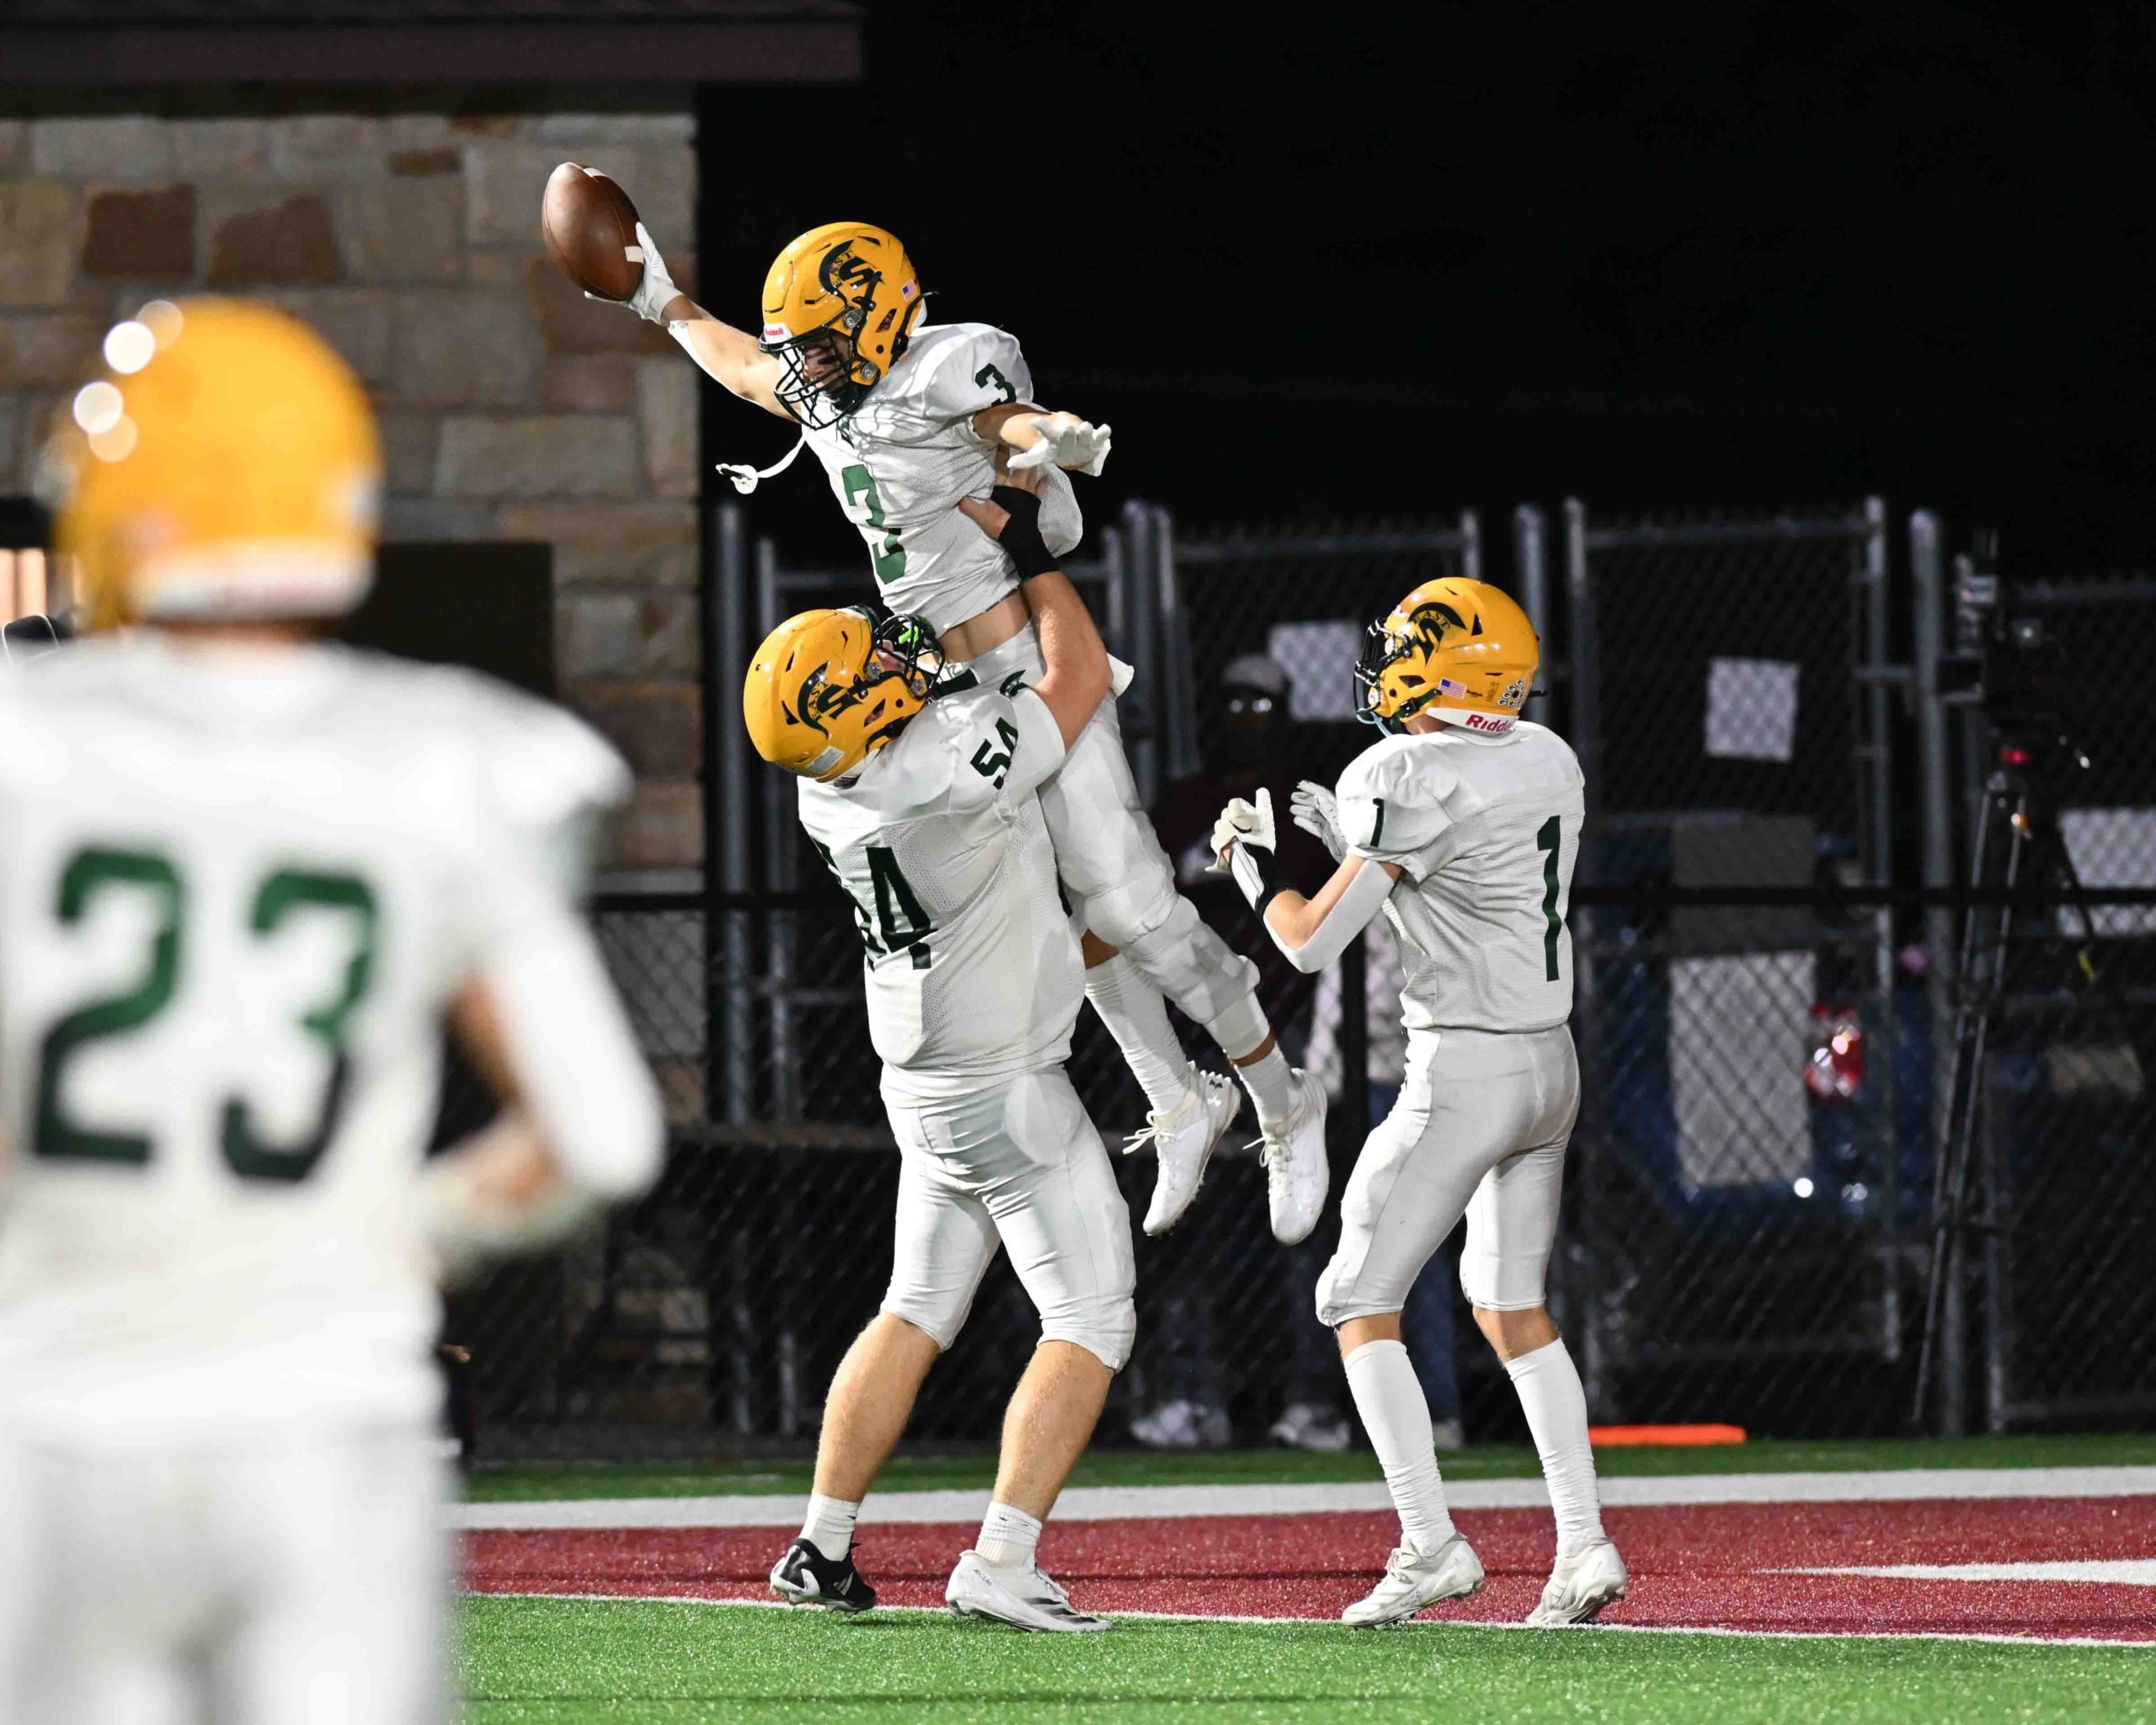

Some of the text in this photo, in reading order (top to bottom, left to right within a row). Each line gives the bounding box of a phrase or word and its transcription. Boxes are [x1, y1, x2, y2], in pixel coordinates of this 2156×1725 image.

[974, 363, 1017, 407] 3
[841, 464, 907, 585] 3
[969, 716, 1019, 790] 54
[1372, 798, 1385, 847] 1
[1537, 815, 1562, 982] 1
[32, 846, 381, 1186] 23
